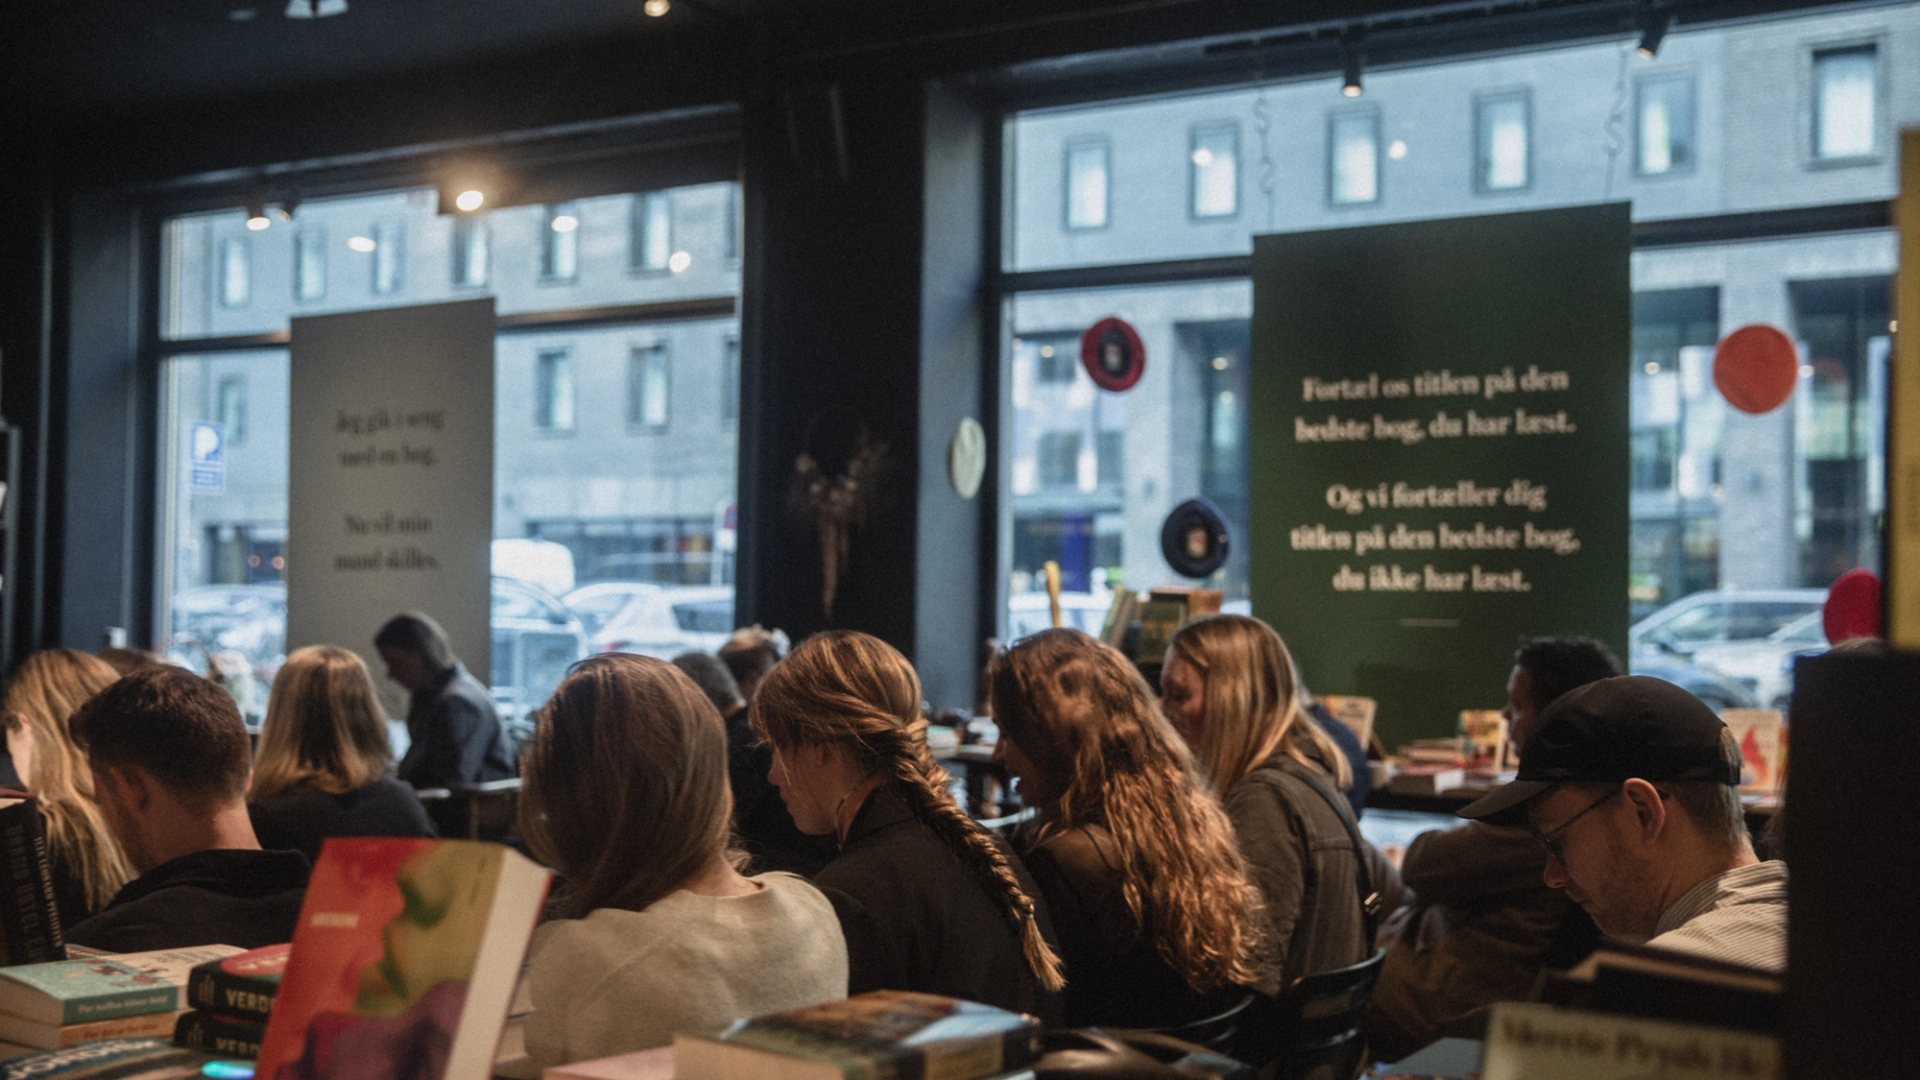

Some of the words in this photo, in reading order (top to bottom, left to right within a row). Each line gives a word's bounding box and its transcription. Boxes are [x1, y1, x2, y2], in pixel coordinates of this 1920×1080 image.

[1303, 372, 1379, 401] Fortæl
[1382, 379, 1411, 398] os
[1414, 369, 1480, 397] titlen
[1484, 366, 1516, 400] på
[1519, 364, 1570, 392] den
[1295, 414, 1371, 443] bedste
[1373, 413, 1426, 444] bog,
[1429, 411, 1463, 438] du
[1466, 409, 1512, 436] har
[1515, 407, 1577, 435] læst.
[1326, 484, 1364, 515] Og
[1366, 482, 1389, 508] vi
[1392, 480, 1501, 508] fortæller
[1503, 478, 1548, 512] dig
[1290, 523, 1352, 550] titlen
[1355, 523, 1386, 556] på
[1388, 522, 1436, 549] den
[1439, 522, 1521, 549] bedste
[1524, 521, 1581, 555] bog,
[1332, 564, 1366, 591] du
[1369, 563, 1422, 591] ikke
[1424, 563, 1469, 591] har
[1472, 564, 1532, 591] læst.
[38, 858, 54, 900] LEONARD
